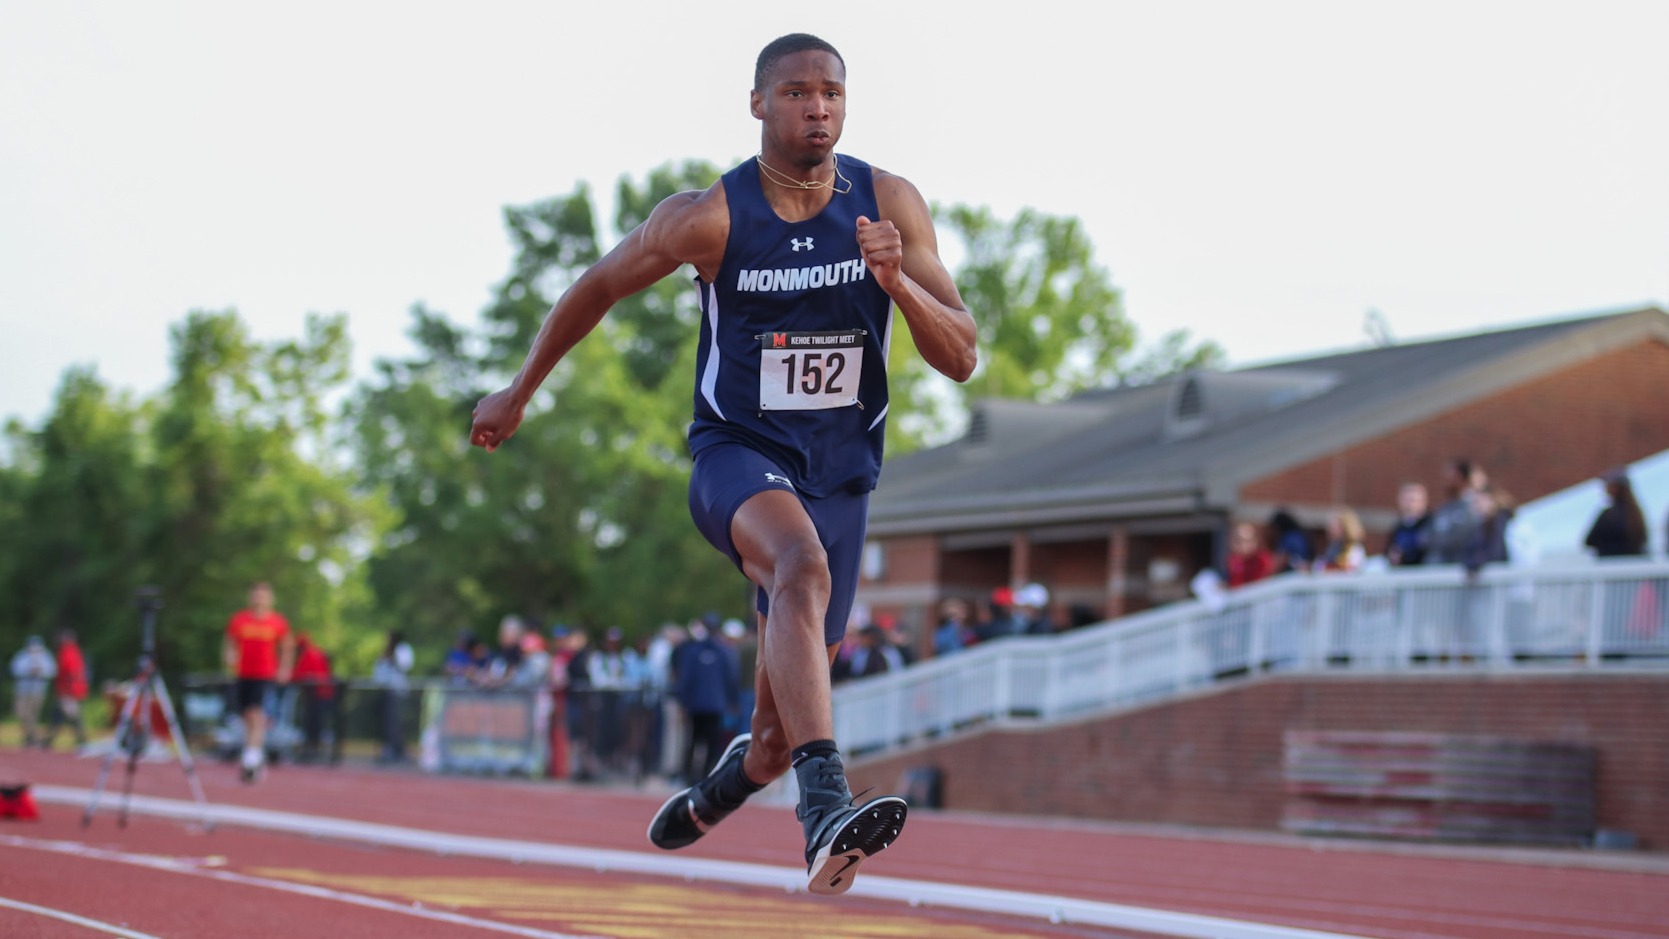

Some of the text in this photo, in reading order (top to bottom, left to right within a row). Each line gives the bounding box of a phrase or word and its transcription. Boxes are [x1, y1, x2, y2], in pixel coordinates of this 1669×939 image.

[737, 258, 866, 292] MONMOUTH
[791, 335, 855, 345] KEHOE TWILIGHT MEET
[781, 352, 846, 395] 152
